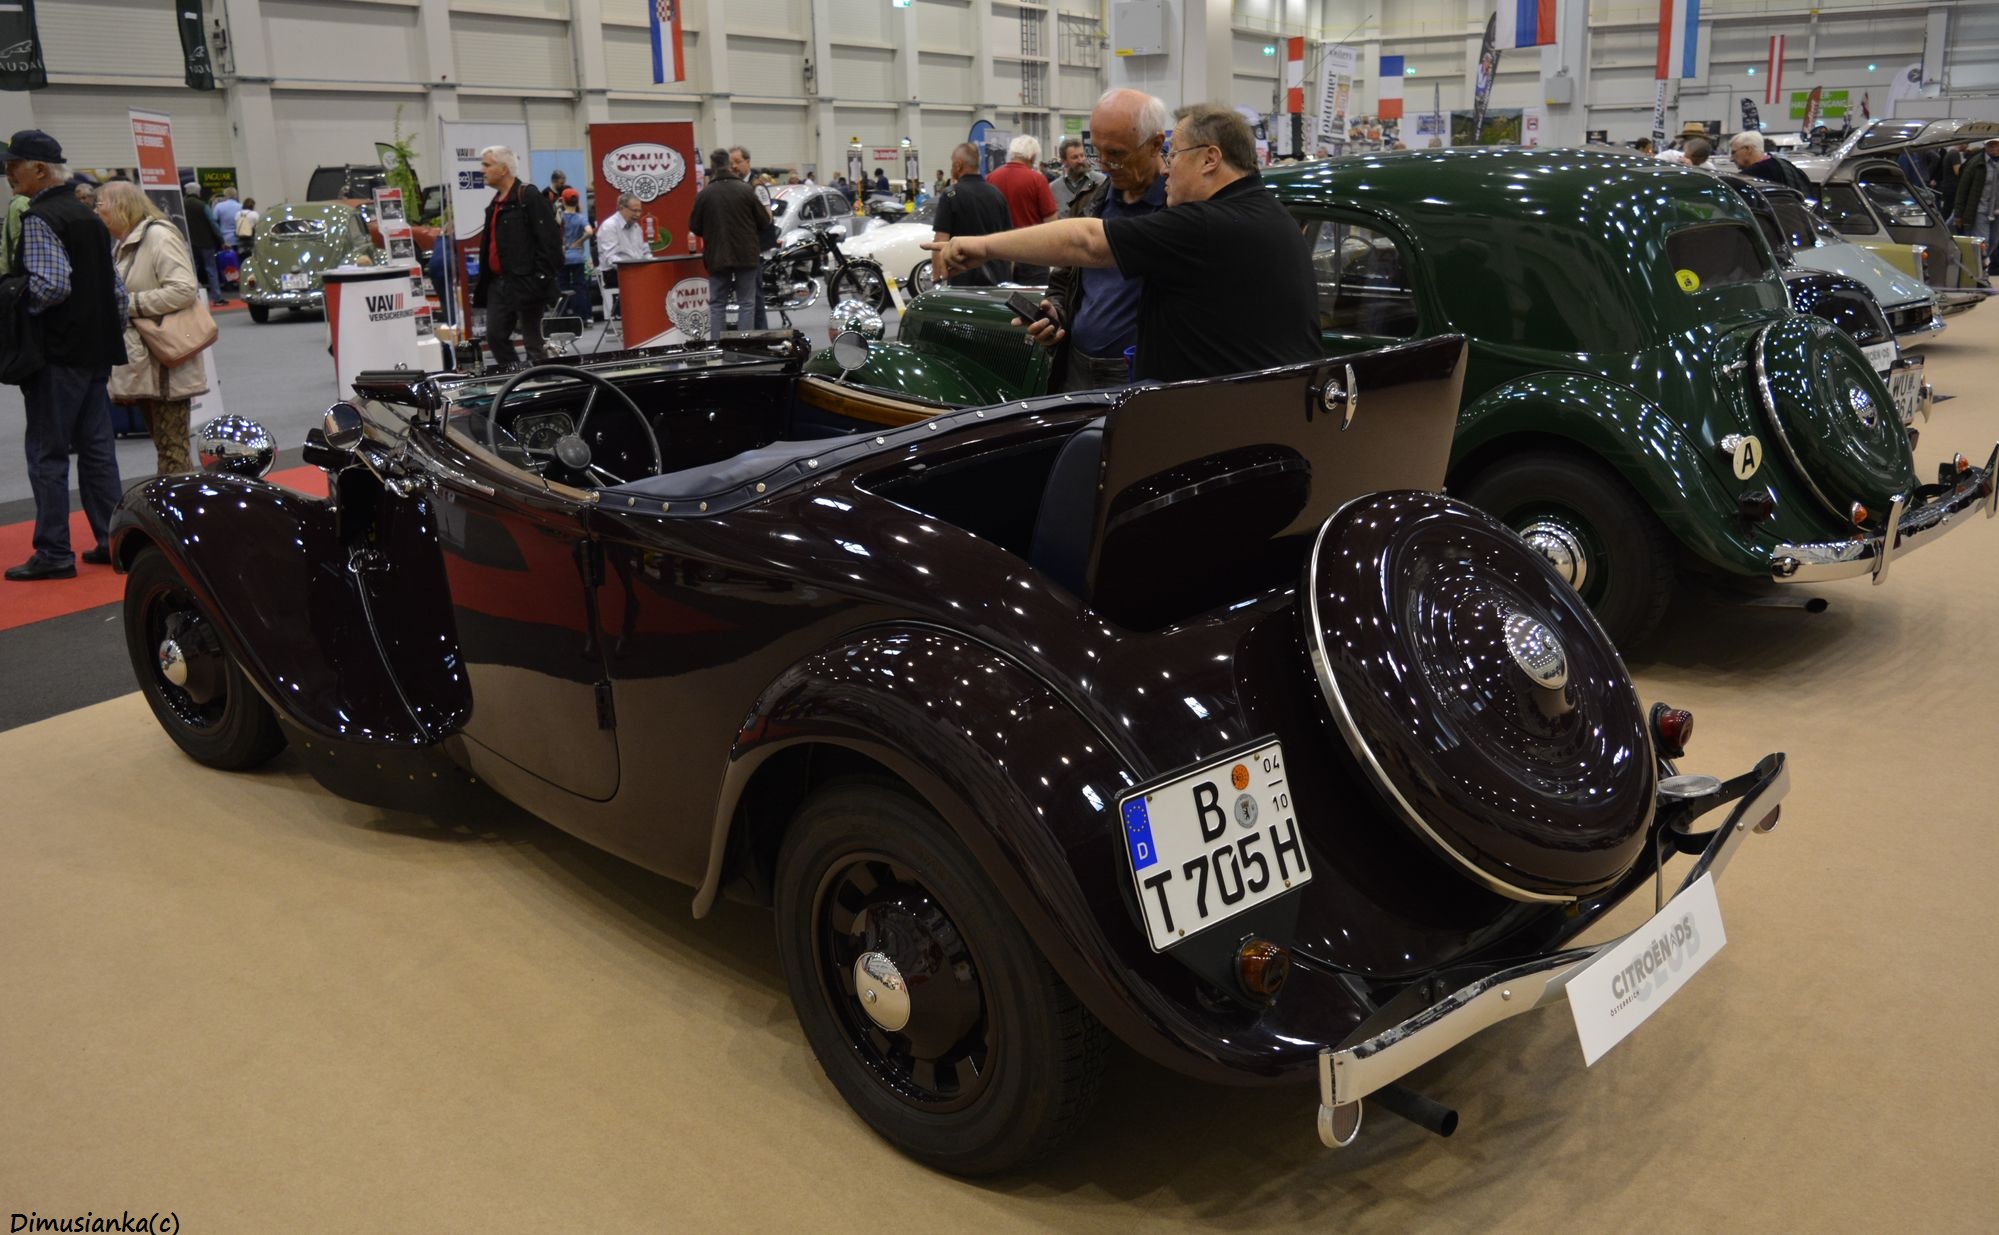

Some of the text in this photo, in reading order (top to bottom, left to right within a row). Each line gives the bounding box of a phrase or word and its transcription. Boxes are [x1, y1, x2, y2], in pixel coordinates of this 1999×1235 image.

[1741, 442, 1755, 474] A
[1263, 754, 1280, 773] 04
[1193, 781, 1227, 843] B
[1272, 793, 1288, 812] 10
[1137, 842, 1149, 861] D
[1610, 990, 1640, 1017] ÖSTERREICH
